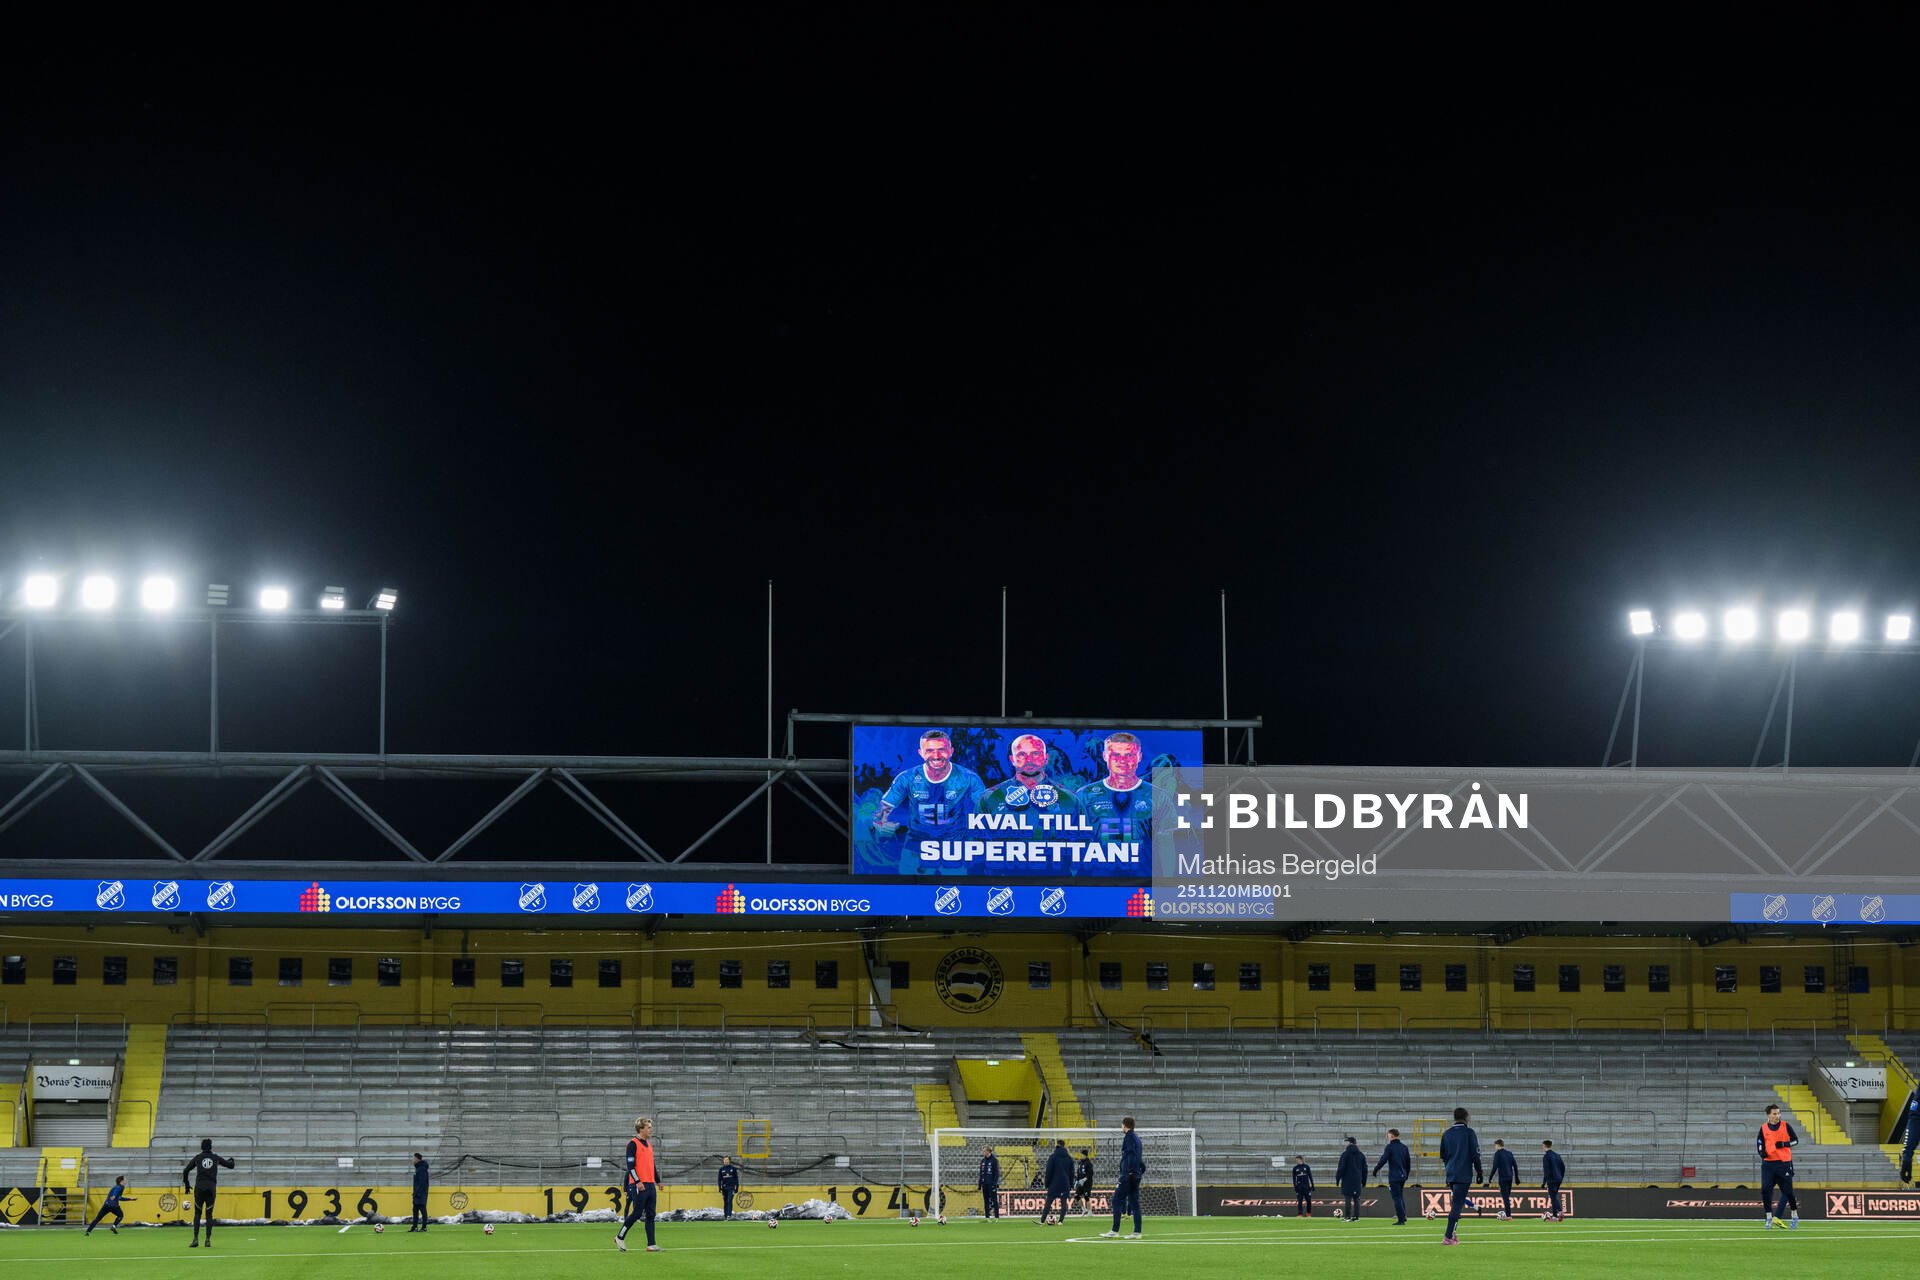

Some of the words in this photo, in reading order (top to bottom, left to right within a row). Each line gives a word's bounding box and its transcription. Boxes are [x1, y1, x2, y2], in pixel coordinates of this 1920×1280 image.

[968, 813, 1033, 830] KVAL
[1039, 814, 1093, 831] TILL
[920, 840, 1139, 863] SUPERETTAN!
[11, 895, 54, 908] BYGG
[335, 896, 416, 909] OLOFSSON
[420, 897, 461, 910] BYGG
[751, 898, 827, 911] OLOFSSON
[831, 899, 871, 912] BYGG
[1160, 902, 1235, 914] OLOFSSON
[70, 1075, 112, 1089] Tidning
[262, 1189, 378, 1219] 1936
[544, 1187, 622, 1217] 193
[1829, 1195, 1862, 1215] XL
